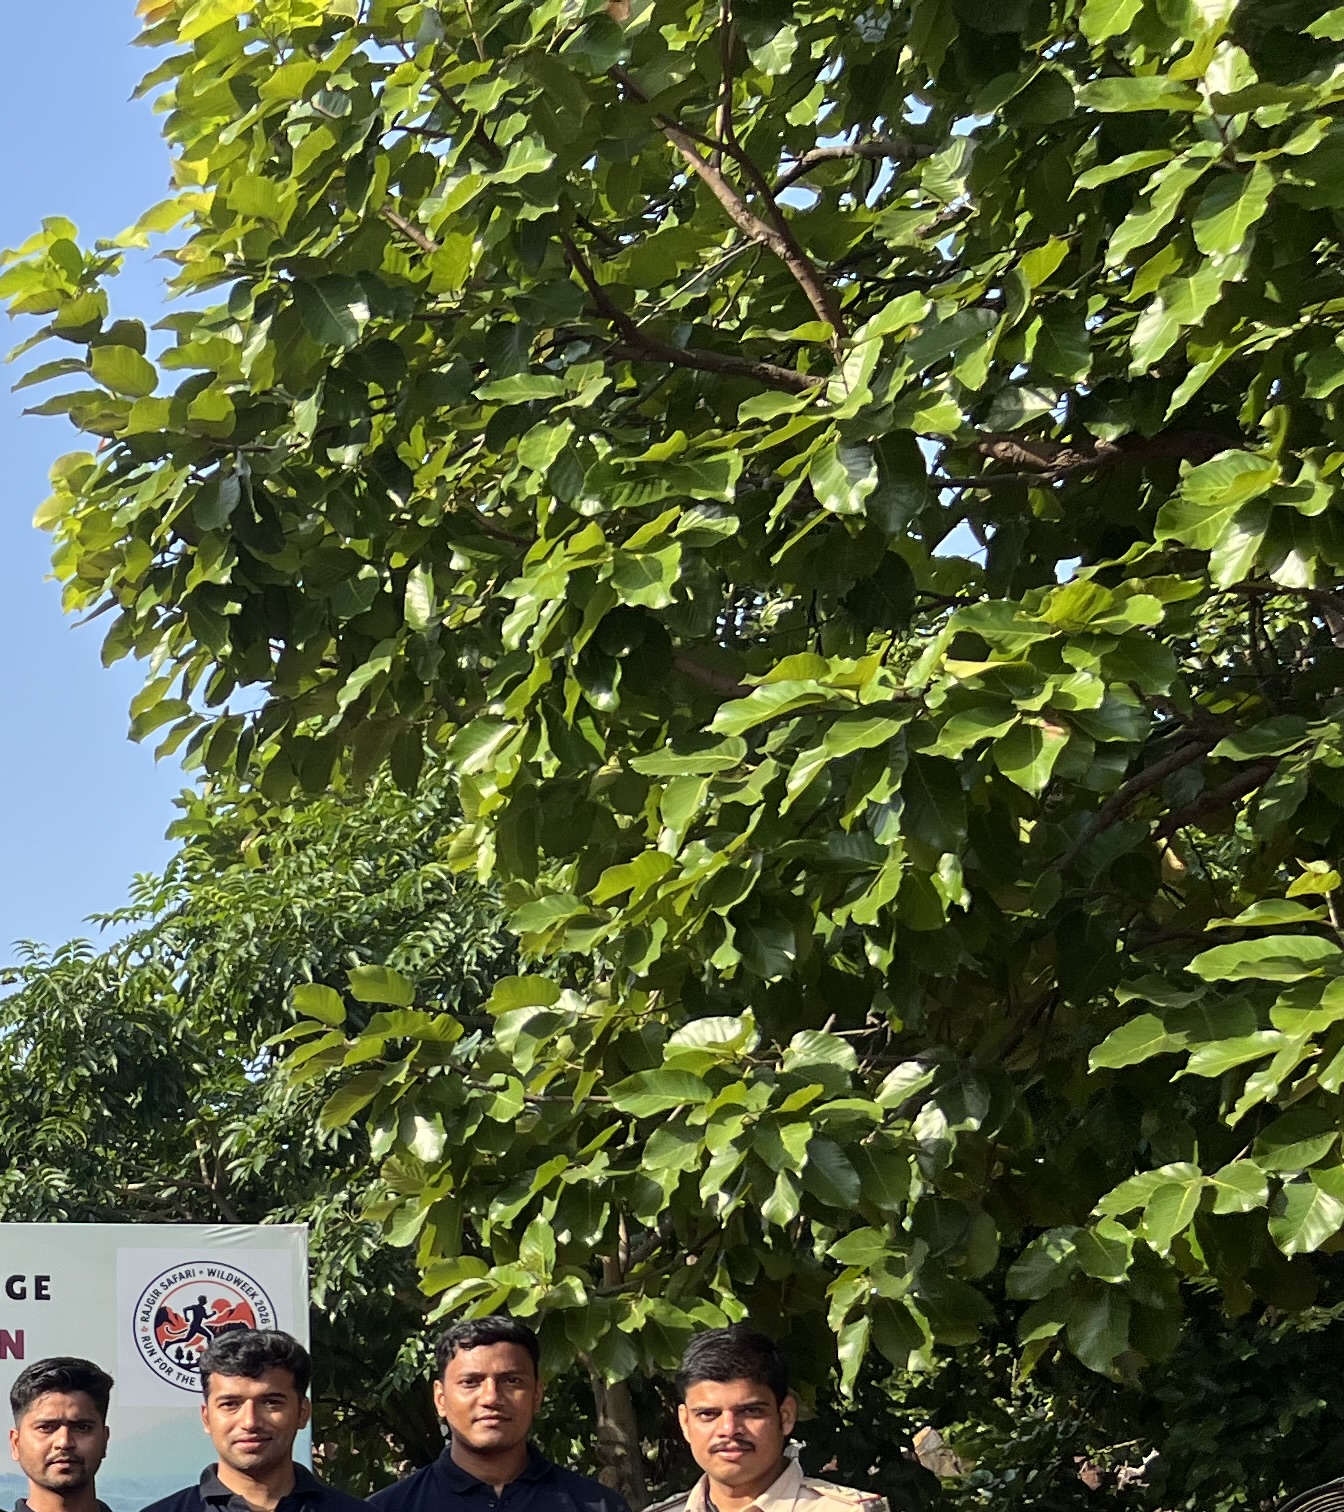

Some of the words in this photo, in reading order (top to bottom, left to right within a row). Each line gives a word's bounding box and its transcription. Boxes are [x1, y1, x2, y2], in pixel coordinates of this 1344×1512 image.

[141, 1289, 163, 1323] RAJGIR
[159, 1268, 196, 1291] SAFARI
[207, 1268, 260, 1301] WILDWEEK
[254, 1299, 272, 1325] 2026
[140, 1335, 155, 1358] RUN
[153, 1357, 174, 1377] FOR
[175, 1371, 197, 1387] THE
